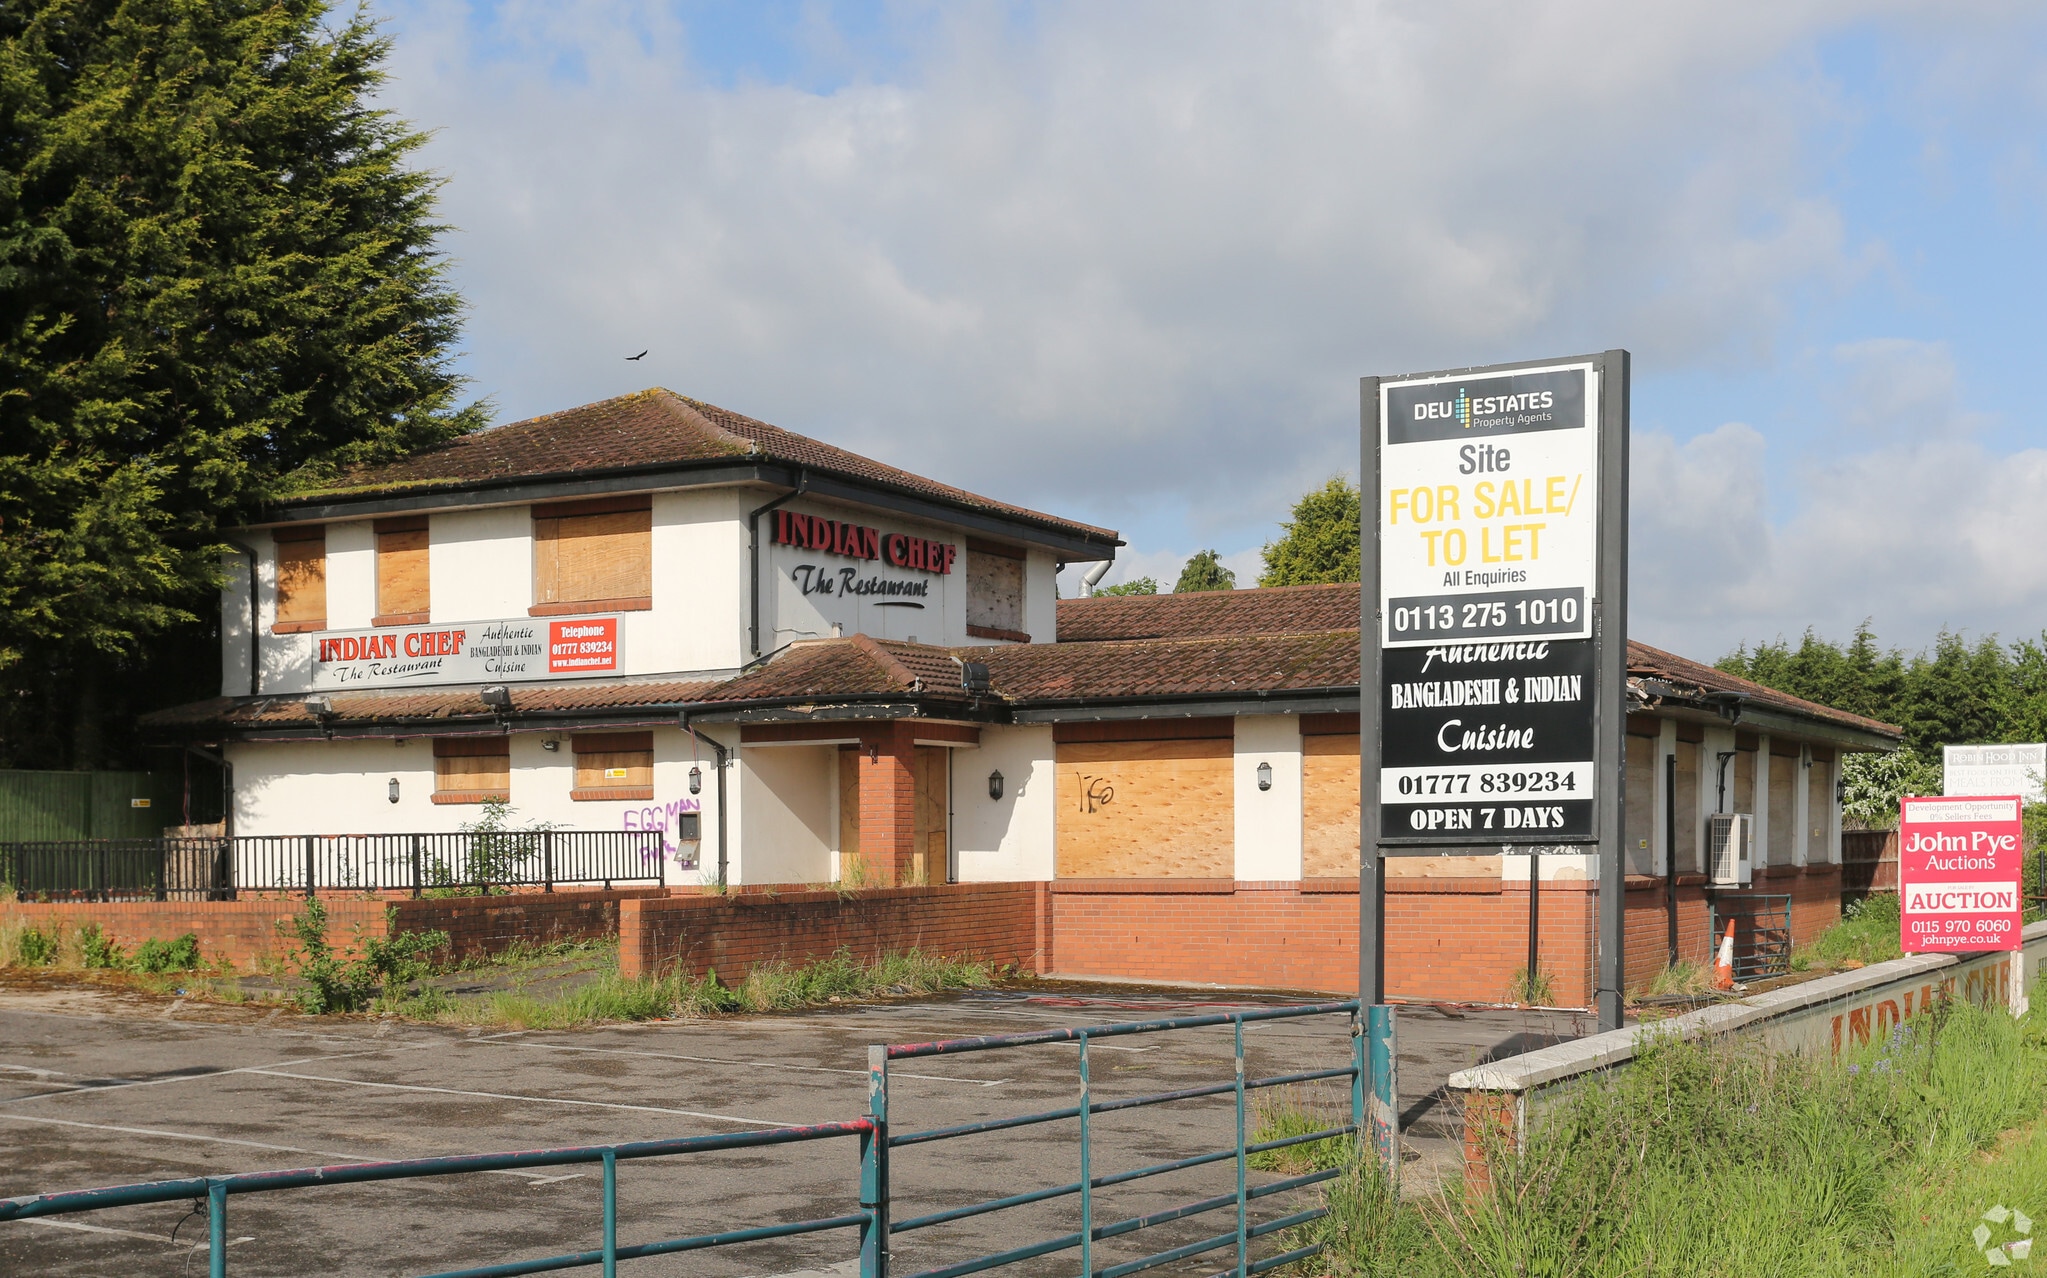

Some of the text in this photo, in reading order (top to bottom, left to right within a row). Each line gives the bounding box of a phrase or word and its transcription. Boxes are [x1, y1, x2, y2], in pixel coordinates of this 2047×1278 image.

[1414, 391, 1553, 420] DEU ESTATES
[1473, 412, 1552, 428] Property Agents
[1459, 444, 1511, 475] Site
[1390, 474, 1582, 525] FOR SALE/
[772, 510, 956, 575] INDIAN CHEF
[1420, 523, 1547, 567] TO LET
[792, 564, 928, 598] The Restaurant
[1443, 568, 1527, 588] All Enquiries
[1394, 598, 1577, 631] 0113 275 1010
[480, 625, 534, 643] Authentic
[561, 625, 604, 638] Telephone
[319, 629, 466, 662] INDIAN CHEF
[470, 644, 542, 658] BANGLADESHI & INDIAN
[552, 641, 612, 655] 01777 839234
[333, 657, 443, 682] The Restaurant
[485, 658, 526, 673] Cuisine
[552, 656, 612, 667] www.indianchef.net
[1391, 675, 1582, 709] BANGLADESHI & INDIAN
[1437, 719, 1534, 752] Cuisine
[1398, 771, 1576, 795] 01777 839234
[1949, 778, 1986, 788] MEALS
[1990, 777, 2023, 787] FROM
[1908, 801, 2014, 812] Development Opportunity
[1973, 812, 1993, 820] Fees
[1410, 806, 1565, 830] OPEN 7 DAYS
[1905, 831, 2016, 856] John Pye
[1925, 855, 1996, 870] Auctions
[1910, 892, 2013, 910] AUCTION
[1911, 919, 2011, 933] 0115 970 6060
[1921, 933, 2001, 947] johnpye.co.uk
